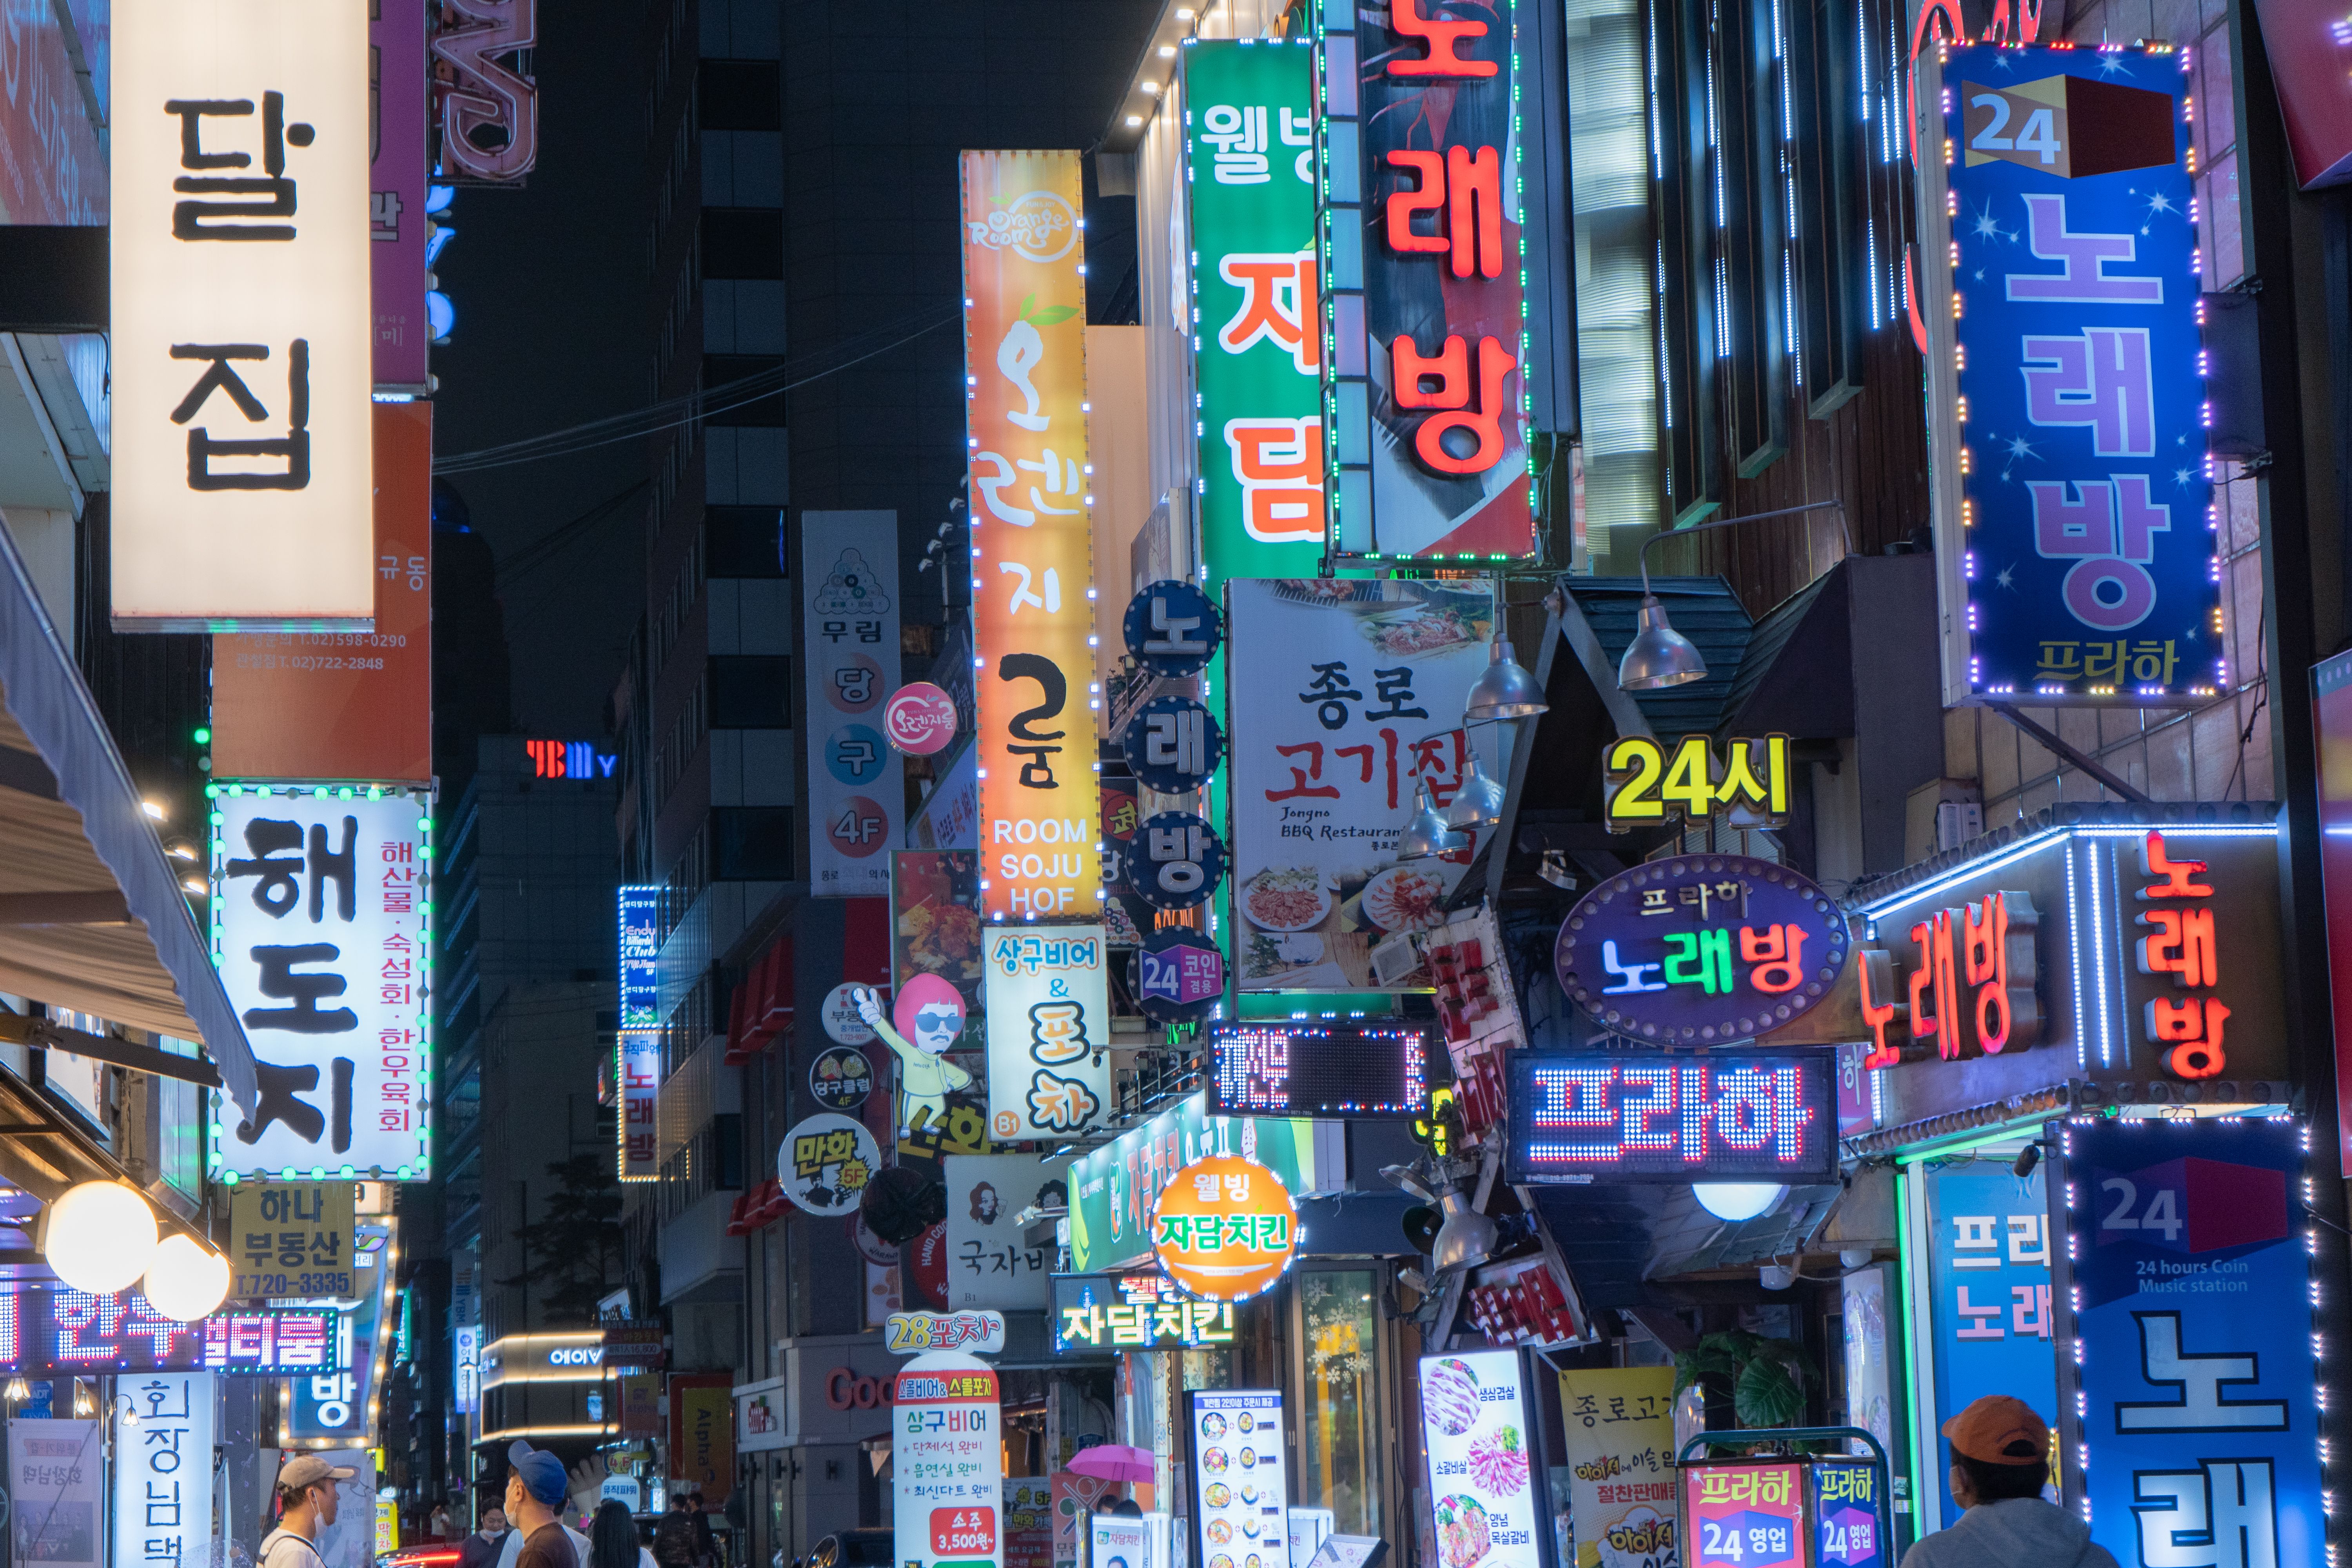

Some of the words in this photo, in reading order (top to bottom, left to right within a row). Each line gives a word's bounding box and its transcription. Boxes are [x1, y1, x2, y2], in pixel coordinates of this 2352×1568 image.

[1971, 93, 2061, 164] 24
[967, 221, 1047, 250] Room
[988, 209, 1070, 240] Orange
[1387, 0, 1517, 474] 노래방
[164, 90, 315, 491] 달집
[2005, 193, 2172, 631] 노래방
[822, 621, 881, 643] 무림
[2033, 639, 2180, 685] 프라하
[1299, 661, 1428, 730] 종로
[835, 668, 877, 777] 당구
[896, 701, 954, 732] 오렌지룸
[1143, 597, 1211, 893] 노래방
[1265, 727, 1466, 809] 고기집
[1612, 738, 1786, 817] 24시
[833, 809, 882, 844] 4F
[1279, 806, 1330, 823] Jongno
[994, 820, 1087, 844] ROOM
[1281, 825, 1314, 841] BBQ
[1000, 853, 1082, 879] SOJU
[1010, 887, 1074, 913] HOF
[1640, 880, 1754, 921] 프라하
[626, 919, 655, 946] Endy
[626, 946, 656, 957] Club
[993, 935, 1098, 975] 상구비어
[1183, 953, 1216, 979] 코인
[1602, 923, 1809, 995] 노래방
[2145, 829, 2231, 1079] 노래방
[226, 815, 358, 1154] 해도지
[1050, 979, 1069, 998] &
[1144, 956, 1179, 996] 24
[1190, 979, 1212, 994] 겸용
[1858, 889, 2011, 1071] 노래방
[830, 1010, 859, 1022] 부동
[1027, 1001, 1100, 1134] 포차
[815, 1078, 870, 1096] 당구클럽
[838, 1096, 851, 1105] 4F
[624, 1063, 656, 1161] 노래방
[998, 1116, 1017, 1132] B1
[1530, 1067, 1814, 1161] 프라하
[794, 1129, 859, 1176] 만화
[844, 1168, 864, 1185] 5F
[1193, 1174, 1250, 1202] 웰빙
[261, 1189, 323, 1223] 하나
[2101, 1177, 2183, 1241] 24
[1158, 1214, 1288, 1253] 자담치킨
[245, 1231, 340, 1267] 부동산
[922, 1238, 935, 1266] HAND
[2137, 1260, 2157, 1274] 24
[2160, 1259, 2207, 1274] hours
[2212, 1259, 2248, 1273] Coin
[236, 1272, 349, 1295] T.720-3335
[964, 1293, 976, 1301] B1
[2139, 1278, 2187, 1292] Music
[2191, 1278, 2248, 1292] station
[889, 1315, 1001, 1350] 28포차
[1062, 1301, 1233, 1345] 자담치킨
[949, 1377, 992, 1397] 스몰포차
[1479, 1386, 1515, 1401] 생삼겹살
[1203, 1398, 1220, 1408] 계란찜
[1221, 1398, 1243, 1408] 2인이상
[1243, 1397, 1261, 1407] 주문시
[1261, 1397, 1273, 1407] 제공
[907, 1410, 986, 1433] 상구비어
[695, 1408, 710, 1466] Alpha
[913, 1441, 955, 1456] 단체석
[958, 1441, 982, 1455] 완비
[913, 1463, 953, 1478] 흡연실
[957, 1463, 981, 1477] 완비
[1436, 1461, 1467, 1475] 소갈비살
[1632, 1447, 1660, 1472] 이슬
[603, 1485, 637, 1495] 뮤직파워
[914, 1485, 967, 1500] 최신다트
[971, 1484, 992, 1499] 완비
[1699, 1470, 1793, 1506] 프라하
[1820, 1468, 1873, 1503] 프라하
[951, 1512, 982, 1531] 소주
[1489, 1513, 1508, 1527] 양념
[1109, 1532, 1140, 1546] 자담치킨
[1491, 1531, 1529, 1545] 목살갈비
[1608, 1518, 1675, 1554] 아이셔
[1703, 1524, 1743, 1562] 24
[1749, 1527, 1786, 1553] 영업
[1824, 1520, 1847, 1559] 24
[1849, 1523, 1871, 1550] 영업
